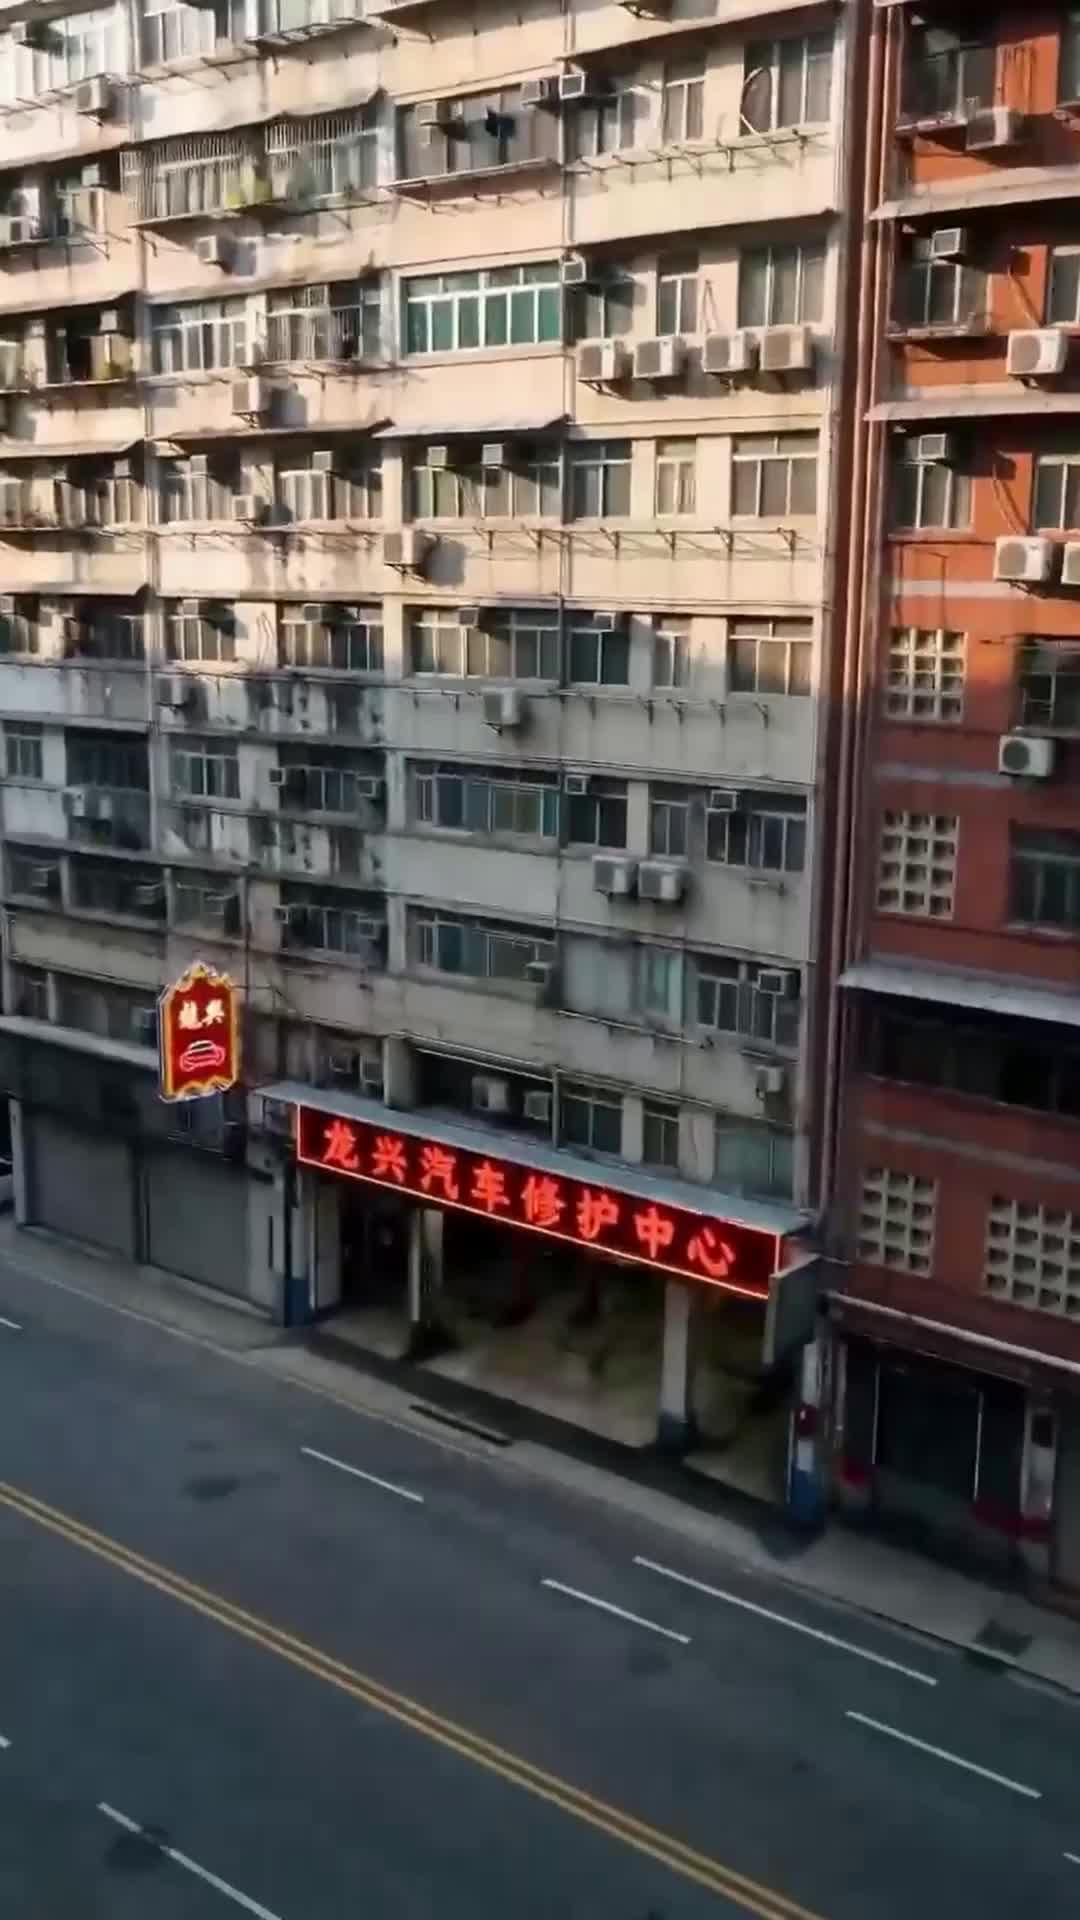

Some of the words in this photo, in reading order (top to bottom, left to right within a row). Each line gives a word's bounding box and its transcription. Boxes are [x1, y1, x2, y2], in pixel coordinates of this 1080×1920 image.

[322, 1121, 736, 1277] 龙兴汽车修护中心
